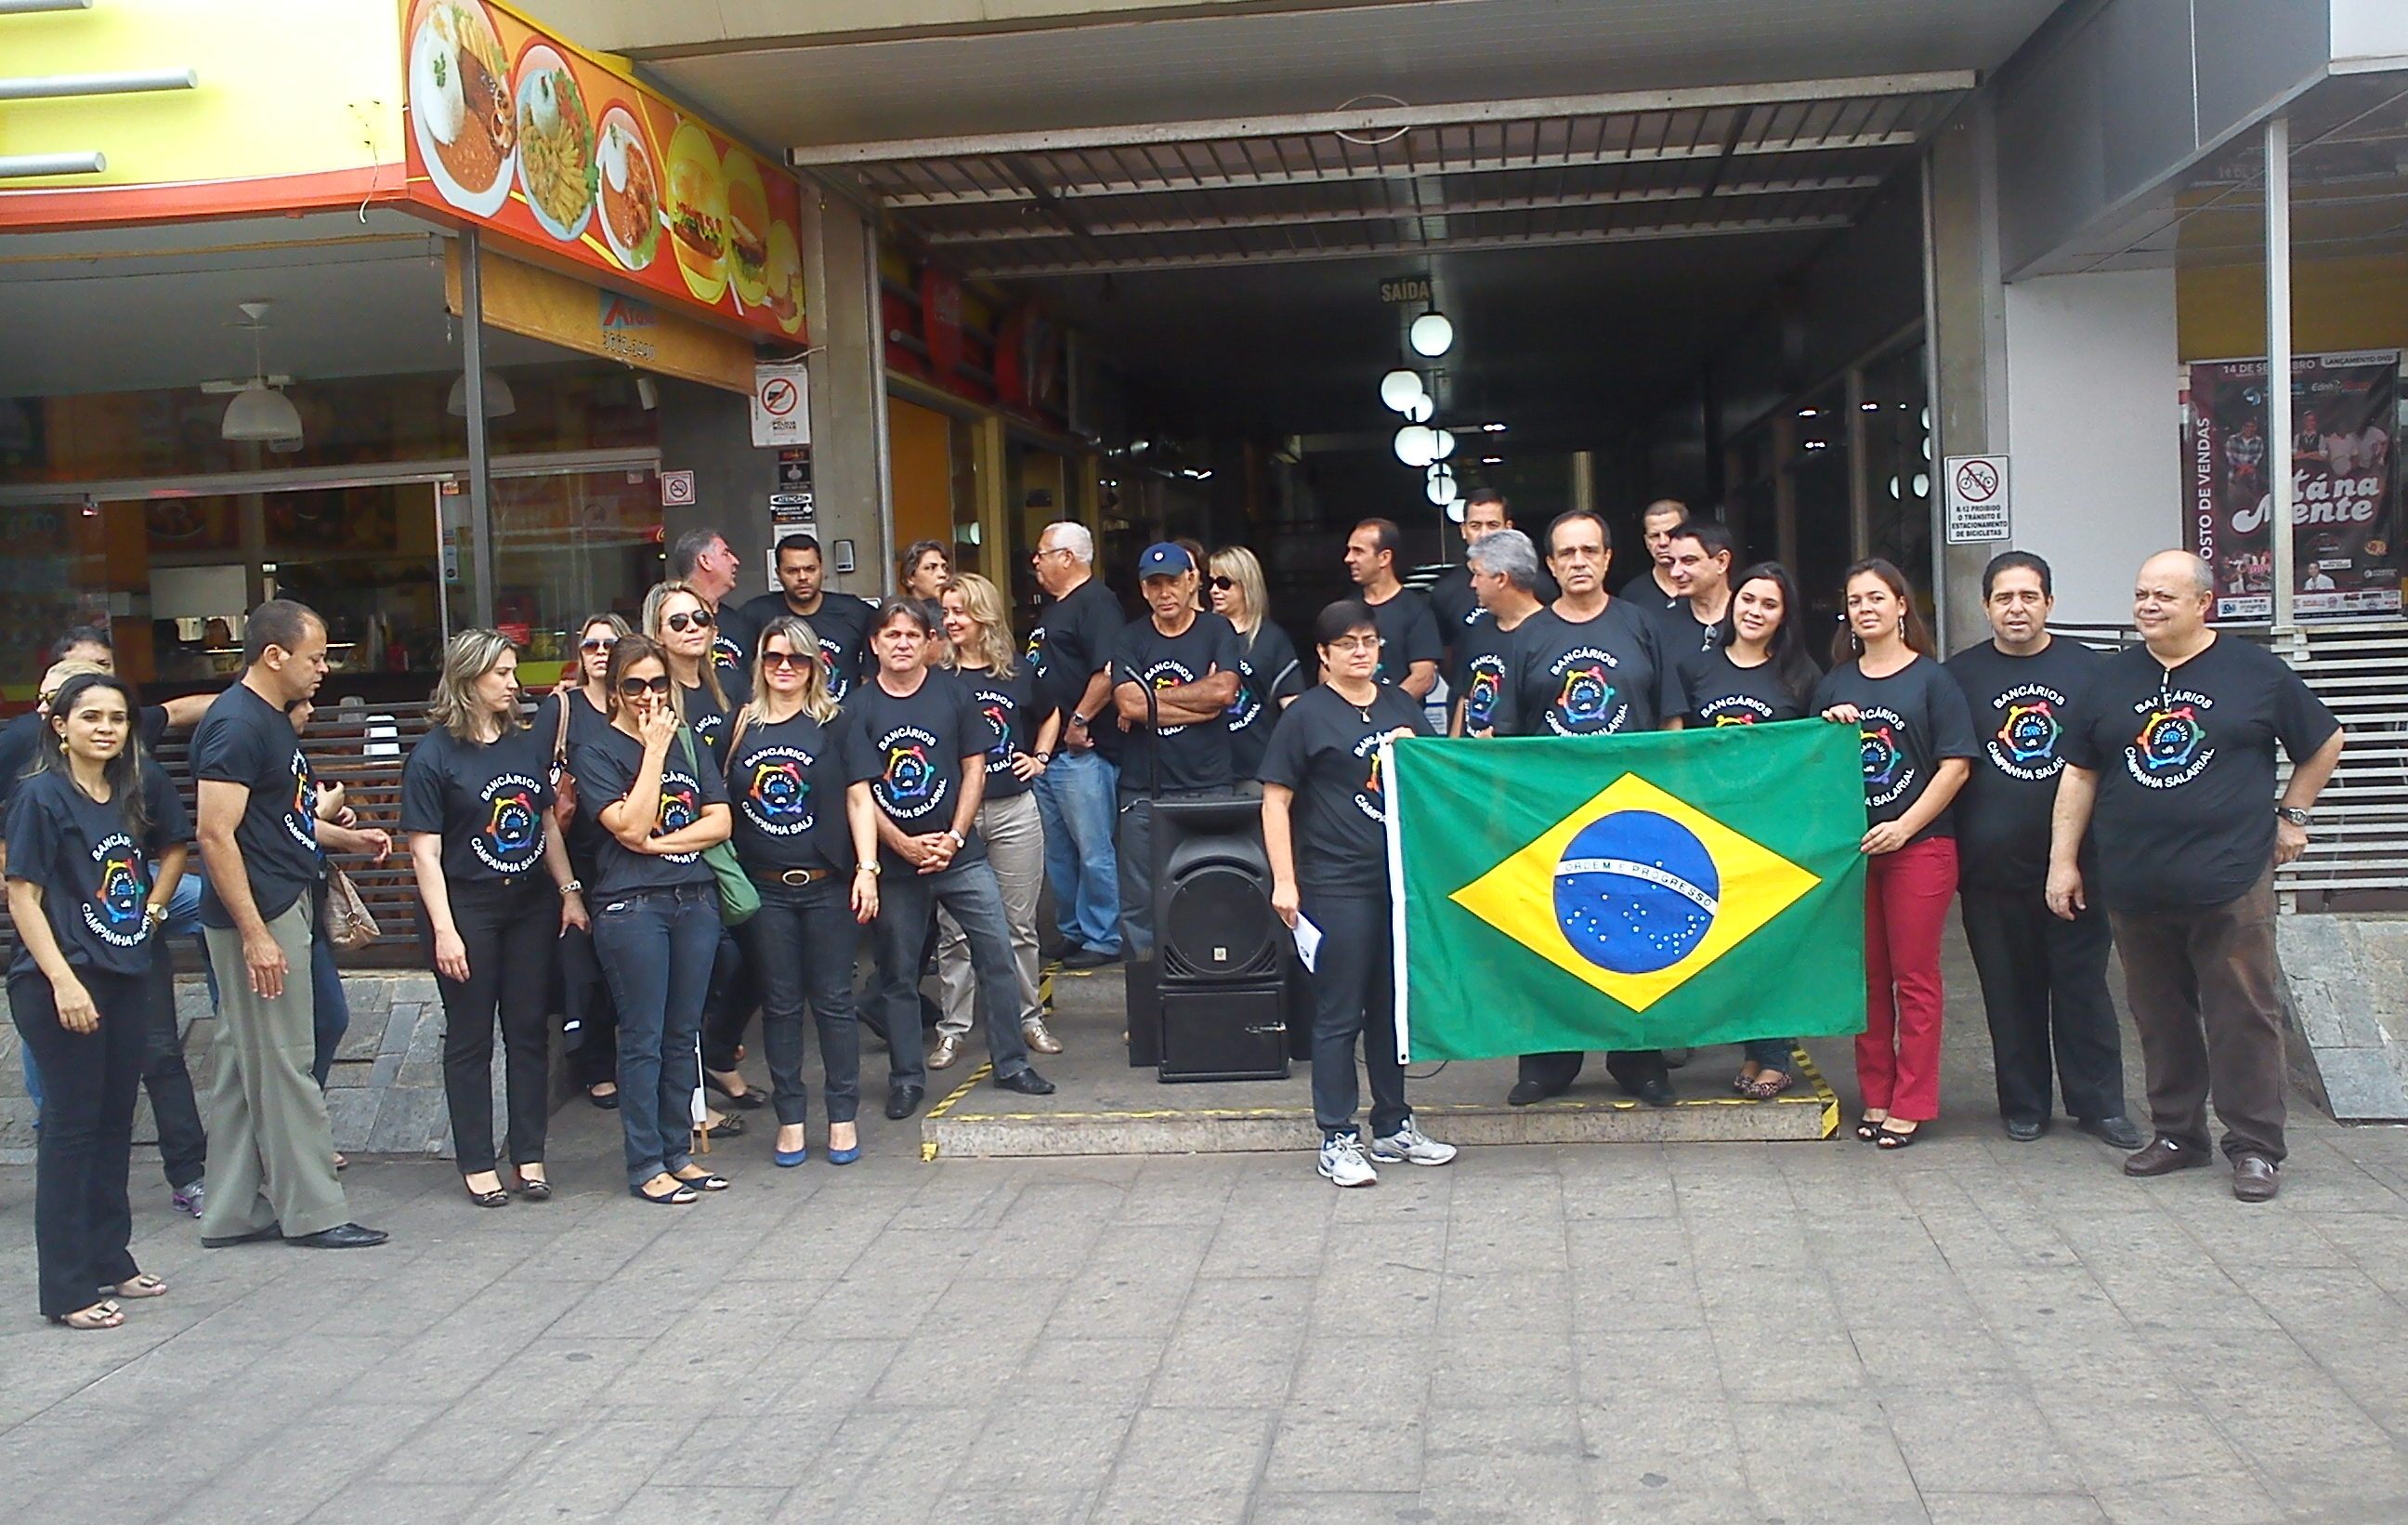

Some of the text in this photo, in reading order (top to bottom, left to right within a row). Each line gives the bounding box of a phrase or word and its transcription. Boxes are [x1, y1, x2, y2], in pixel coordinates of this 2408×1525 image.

[1381, 280, 1429, 302] SAÍDA
[2223, 363, 2236, 374] 14
[2239, 363, 2254, 373] DE
[2325, 355, 2376, 366] LANÇAMENTO
[2197, 417, 2213, 570] OSTO DE VENDAS
[1951, 521, 2008, 530] ESTACIONAMENTO
[1550, 647, 1618, 675] BANCÁRIOS
[1700, 695, 1773, 718] BANCÁRIOS
[1993, 683, 2066, 709] BANCÁRIOS
[1859, 707, 1905, 730] NCÁRIOS
[878, 726, 936, 751] BANCÁRIOS
[744, 746, 814, 768] BANCÁRIOS
[1987, 741, 2066, 781] CAMPANHA SALAR
[2124, 746, 2216, 789] CAMPANHA SALARIAL
[480, 773, 542, 801] BANCÁRIOS
[873, 778, 948, 819] CAMPANHA SALARIAL
[1873, 769, 1915, 807] SALARIAL
[741, 801, 790, 835] CAMPANHA
[471, 837, 521, 873] CAMPANHA
[1565, 861, 1611, 872] ORDEM
[1632, 865, 1712, 907] PROGRESSO
[82, 903, 134, 947] CAMPANHA
